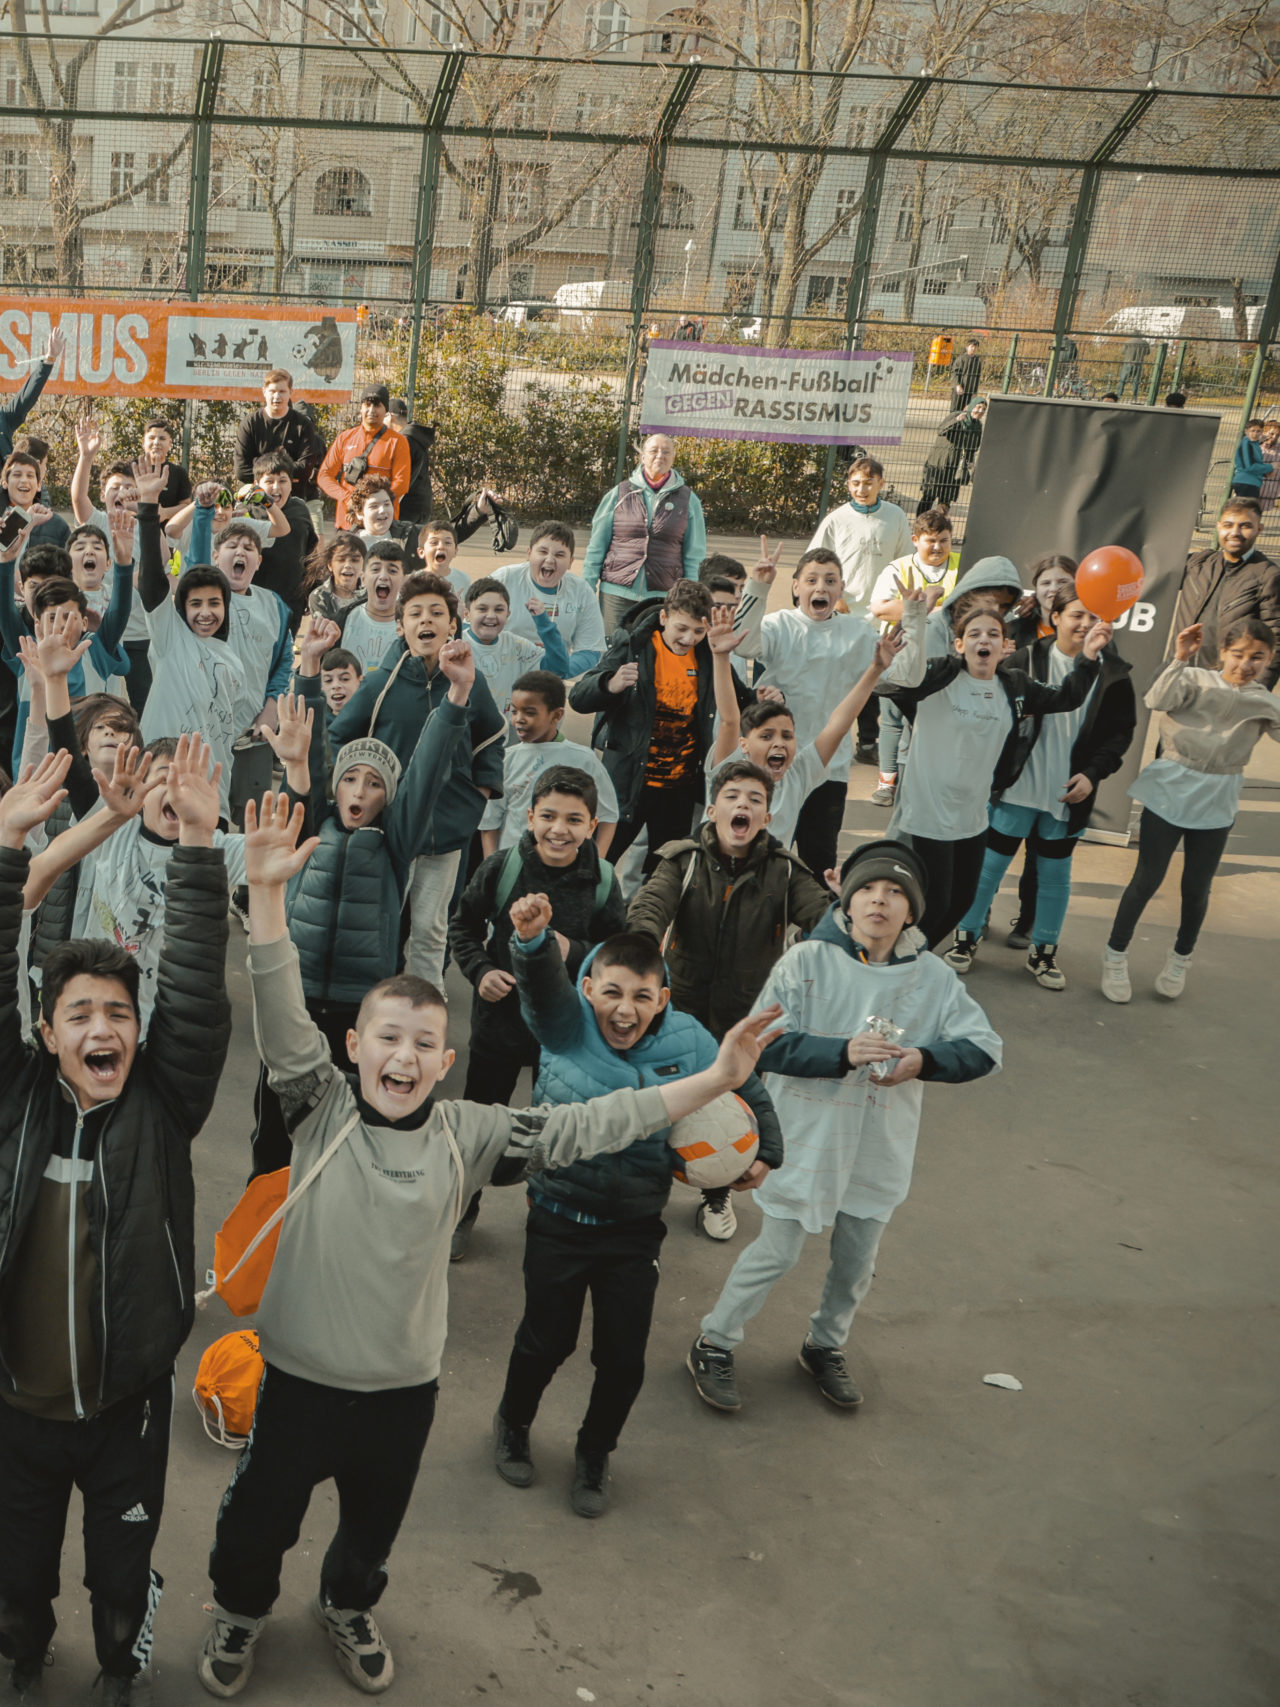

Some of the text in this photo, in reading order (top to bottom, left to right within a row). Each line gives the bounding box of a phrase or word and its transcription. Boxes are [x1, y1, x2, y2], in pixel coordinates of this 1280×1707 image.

[668, 362, 877, 394] Mädchen-Fußball
[667, 390, 873, 424] GEGEN RASSISMUS
[121, 1513, 150, 1522] adidas
